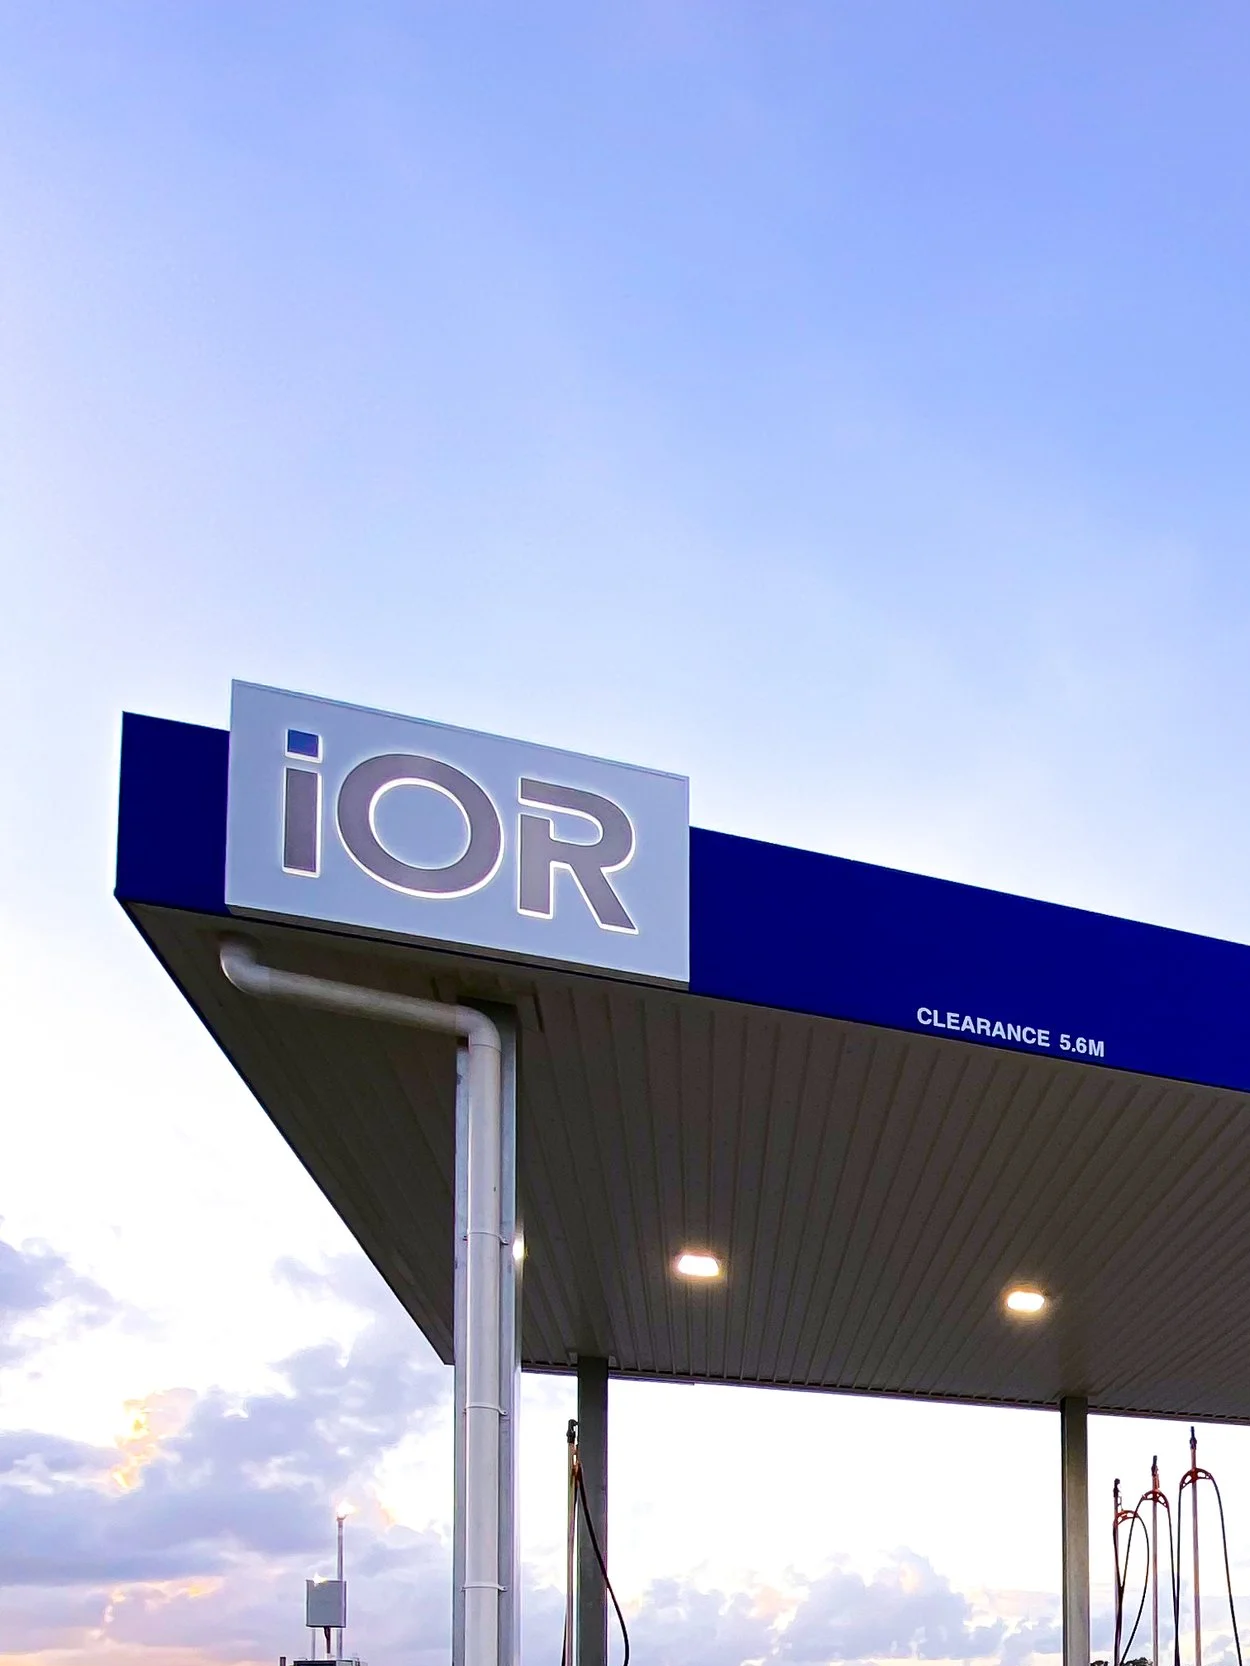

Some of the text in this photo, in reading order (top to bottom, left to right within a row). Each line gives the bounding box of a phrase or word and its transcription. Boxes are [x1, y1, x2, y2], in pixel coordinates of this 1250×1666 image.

[282, 728, 639, 935] iOR
[916, 1007, 1105, 1058] CLEARANCE 5.6M
